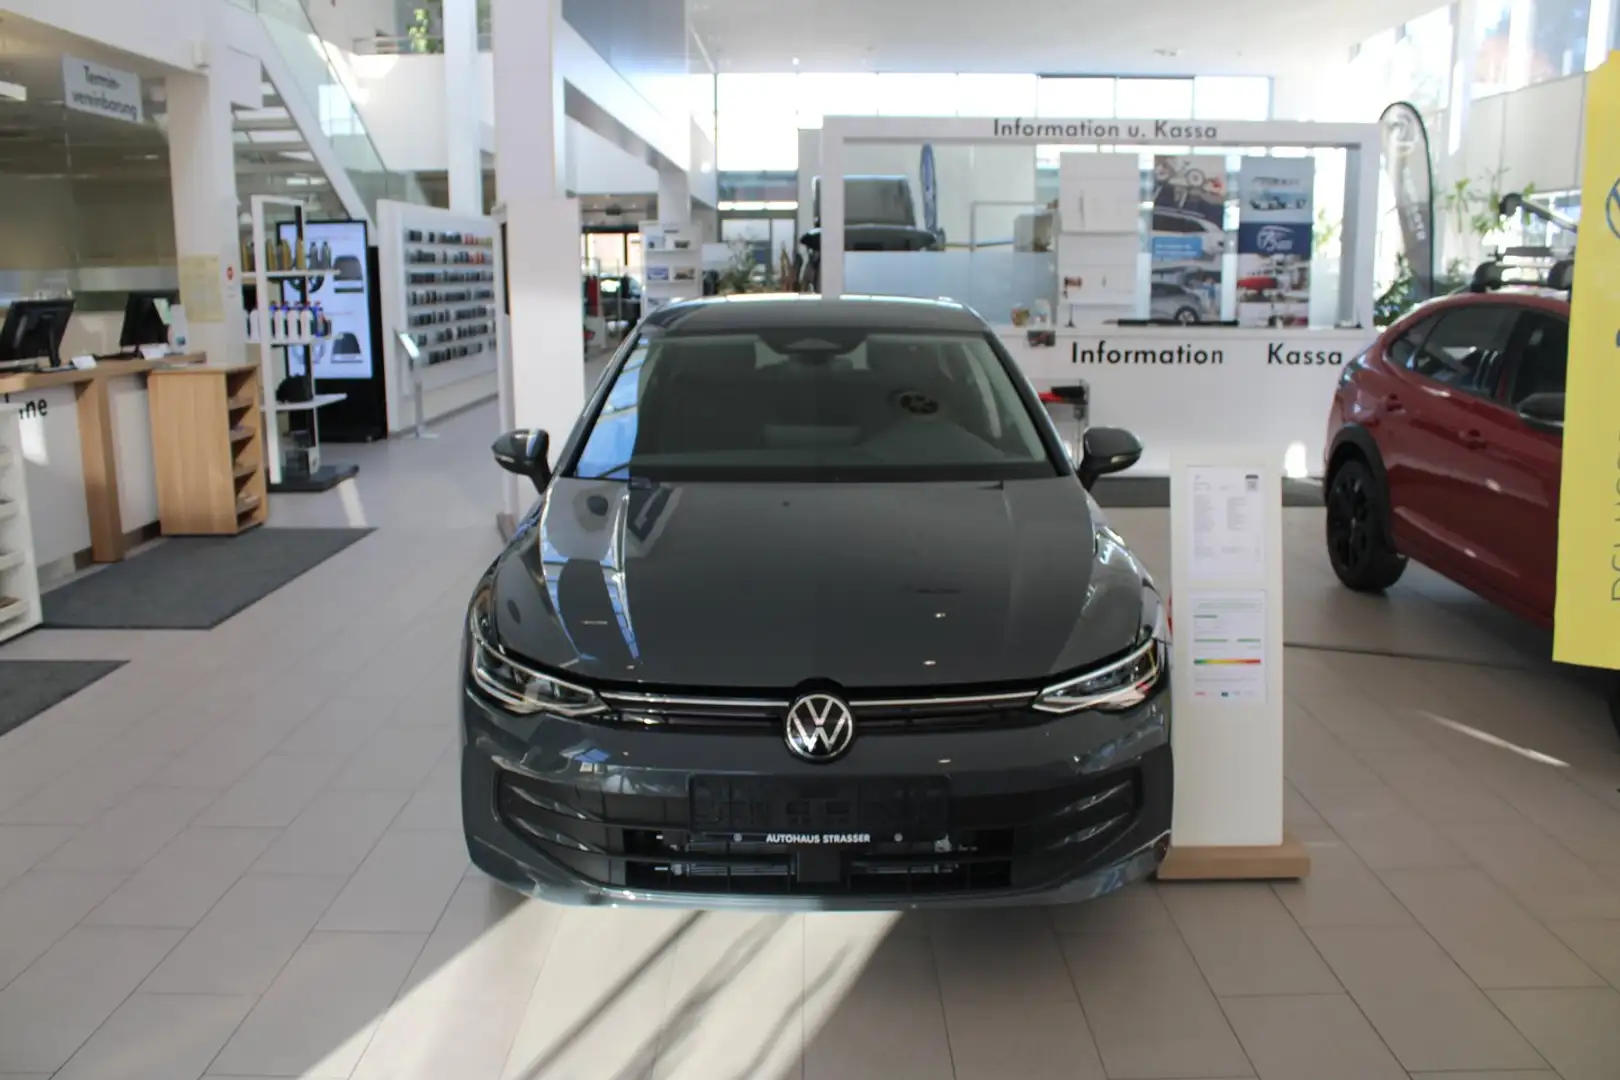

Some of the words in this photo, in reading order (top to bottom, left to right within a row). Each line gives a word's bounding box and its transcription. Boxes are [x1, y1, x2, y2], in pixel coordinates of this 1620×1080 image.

[993, 117, 1120, 138] Information
[1128, 122, 1147, 138] u.
[1155, 119, 1218, 139] Kassa
[1071, 340, 1224, 365] Information
[1267, 342, 1343, 366] Kassa
[765, 832, 821, 845] AUTOHAUS
[822, 833, 871, 844] STRASSER
